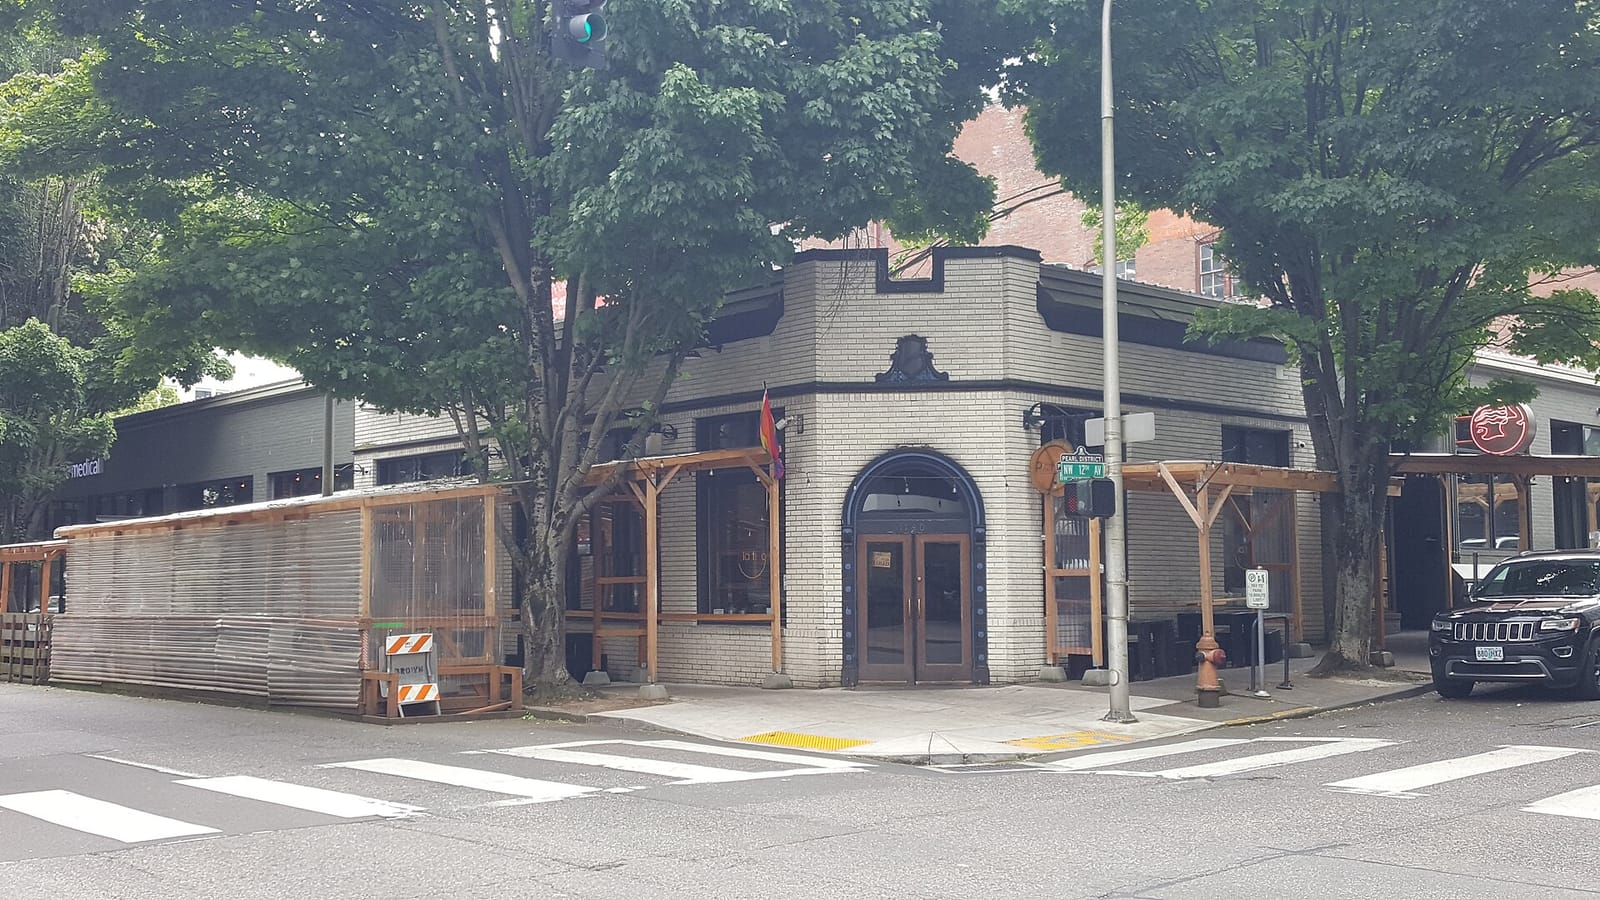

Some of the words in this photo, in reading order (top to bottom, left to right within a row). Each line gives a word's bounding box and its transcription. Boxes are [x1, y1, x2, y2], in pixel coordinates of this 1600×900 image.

[71, 457, 100, 478] medical
[1063, 464, 1073, 475] NW
[1094, 465, 1102, 476] AV
